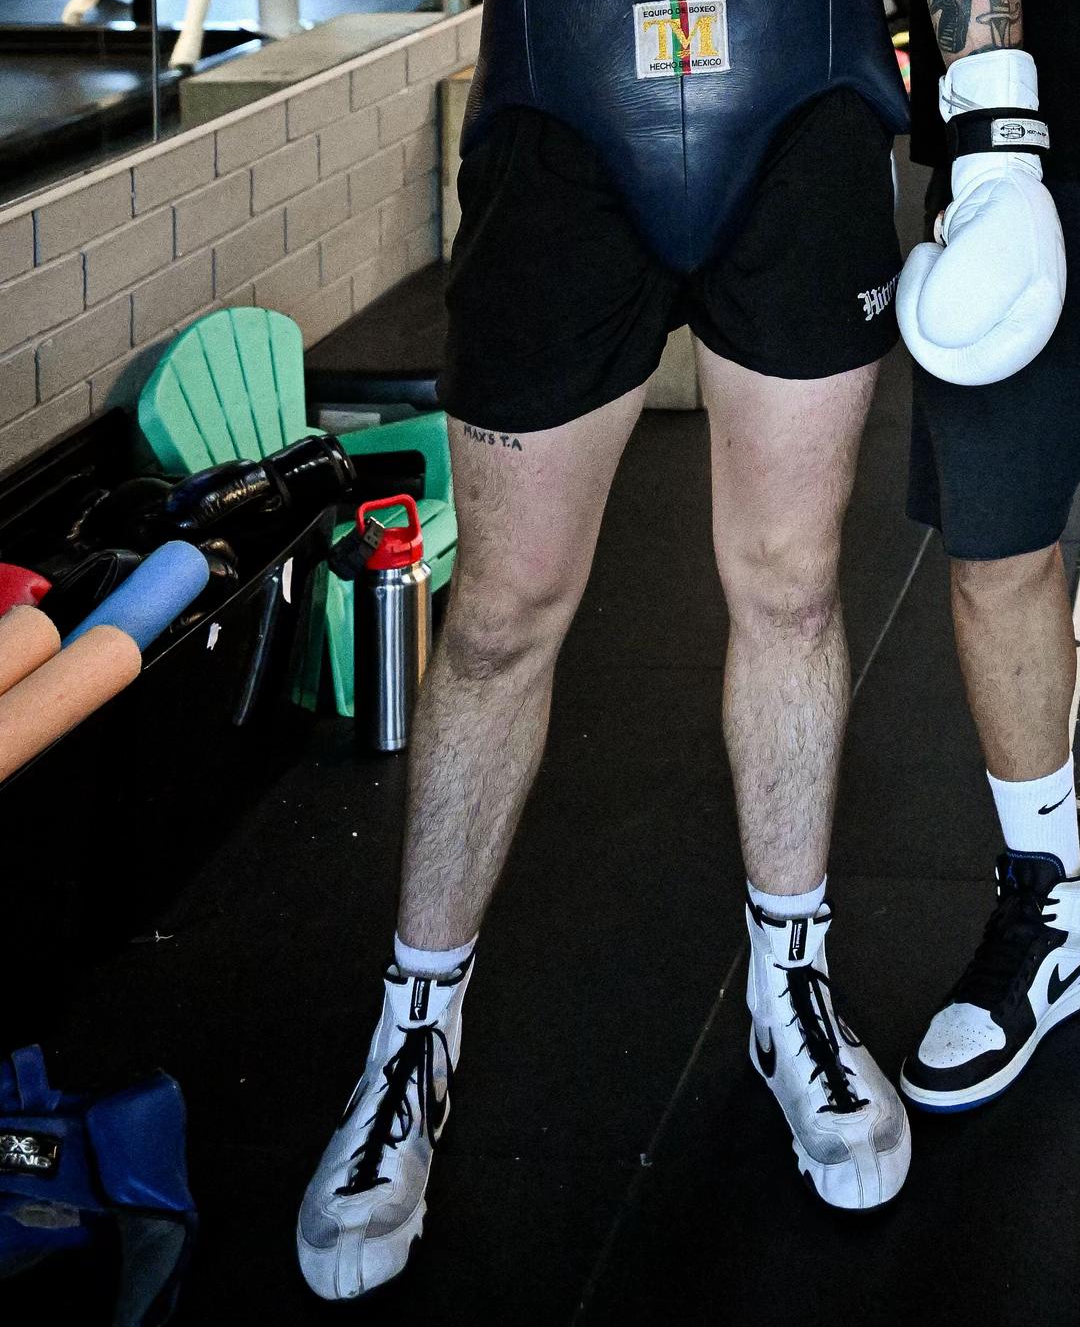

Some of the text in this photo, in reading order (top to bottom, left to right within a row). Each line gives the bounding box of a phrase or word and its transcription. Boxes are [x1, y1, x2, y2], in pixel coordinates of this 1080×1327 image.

[643, 8, 673, 18] EQUIPO
[688, 5, 716, 14] BOXEO
[649, 61, 678, 71] HECHO
[691, 58, 722, 67] MEXICO
